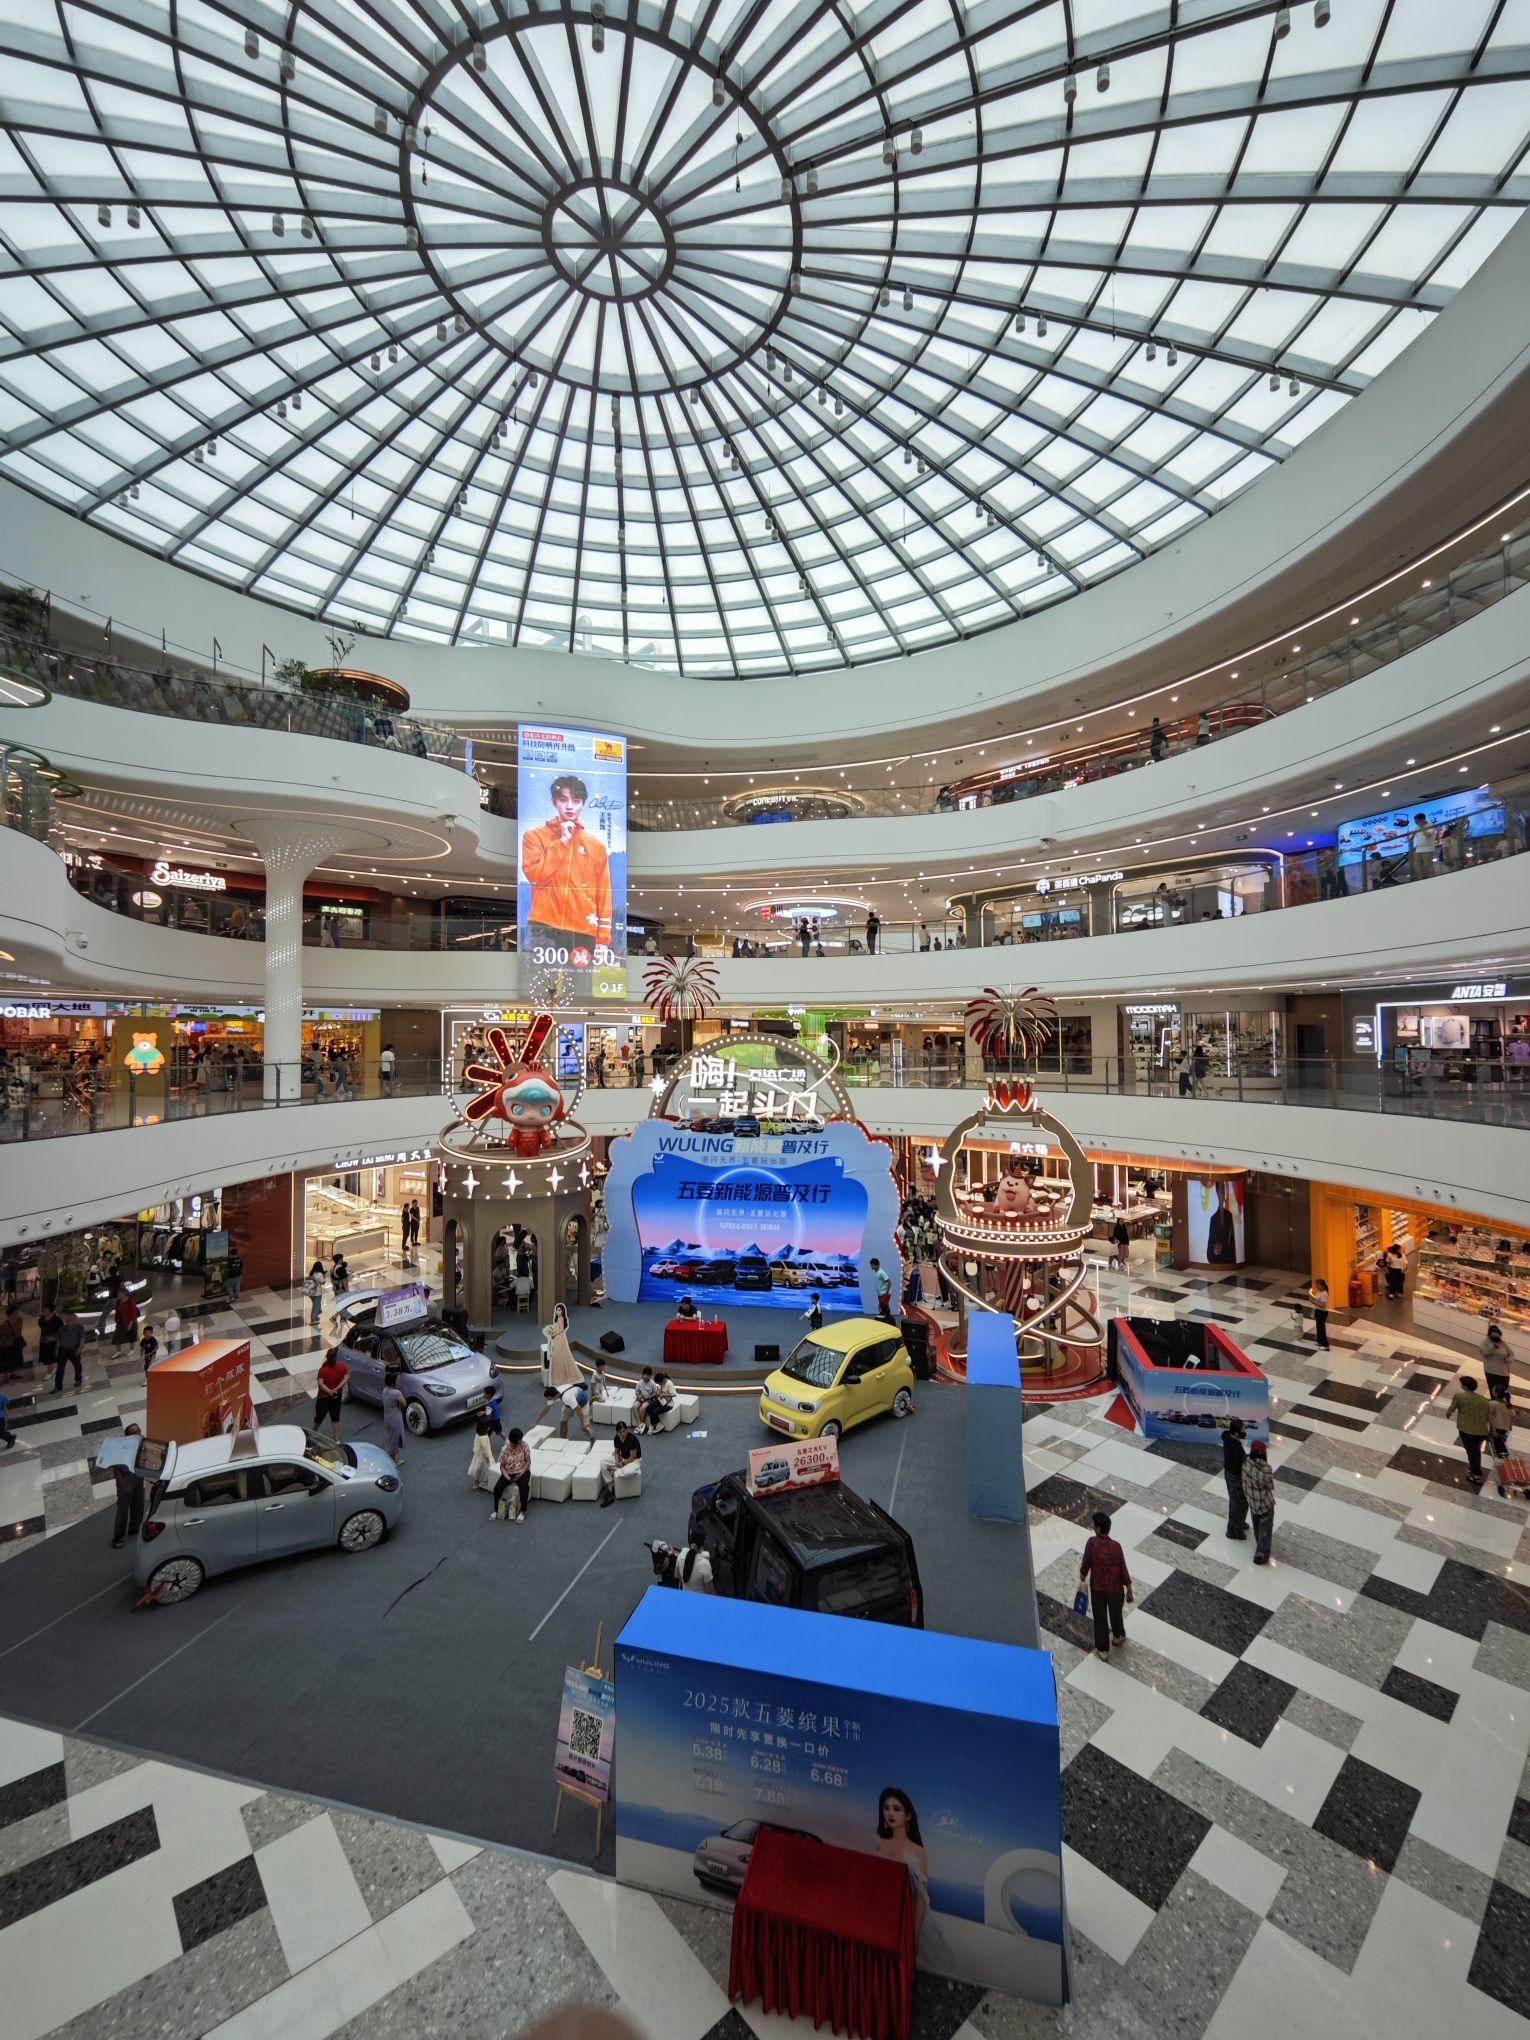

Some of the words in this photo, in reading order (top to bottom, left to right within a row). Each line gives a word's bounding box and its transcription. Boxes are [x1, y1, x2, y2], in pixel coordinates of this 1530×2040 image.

[151, 862, 226, 889] Saizeriya
[1079, 871, 1124, 886] ChaPanda
[532, 946, 568, 965] 300
[592, 949, 615, 966] 50
[611, 983, 624, 993] 1F
[1452, 985, 1482, 999] ANTA
[658, 1137, 734, 1153] WULING
[794, 1452, 826, 1467] 26300
[683, 1689, 841, 1739] 2025款五菱缤果
[709, 1722, 831, 1757] 限时先享置换一口价
[750, 1755, 782, 1774] 6.28
[810, 1768, 844, 1787] 6.68
